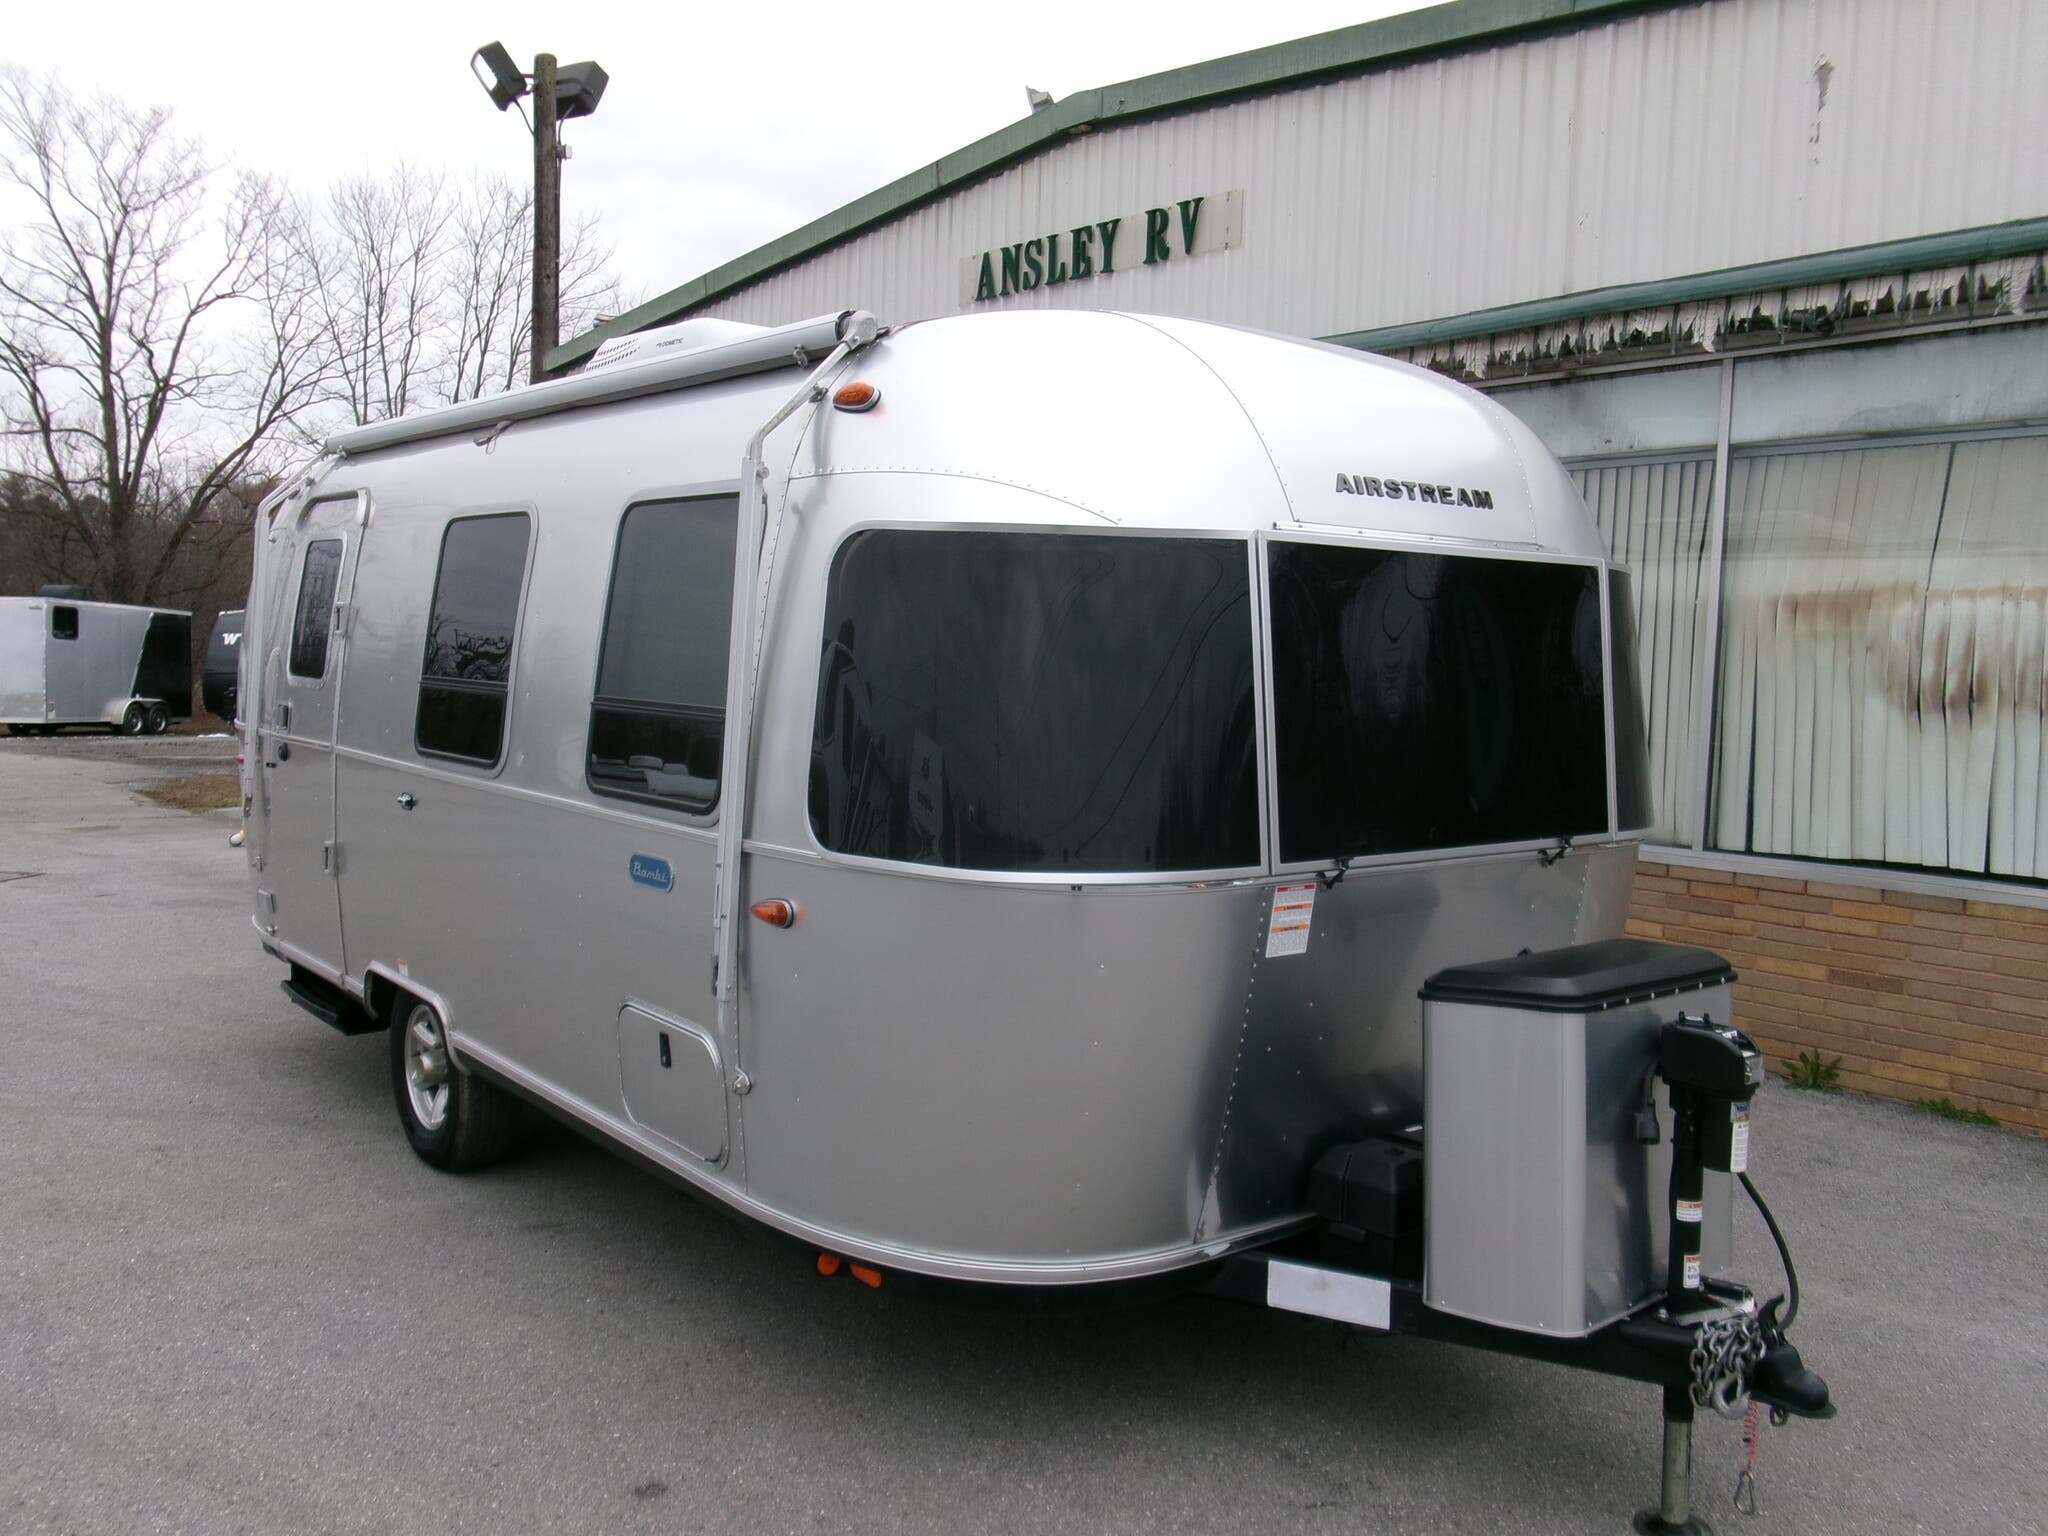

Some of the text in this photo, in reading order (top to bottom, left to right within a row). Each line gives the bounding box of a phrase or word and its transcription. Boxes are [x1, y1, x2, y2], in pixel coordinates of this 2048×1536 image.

[975, 196, 1204, 302] ANSLEY RV
[1335, 472, 1494, 510] AIRSTREAM
[633, 862, 667, 882] Bambi
